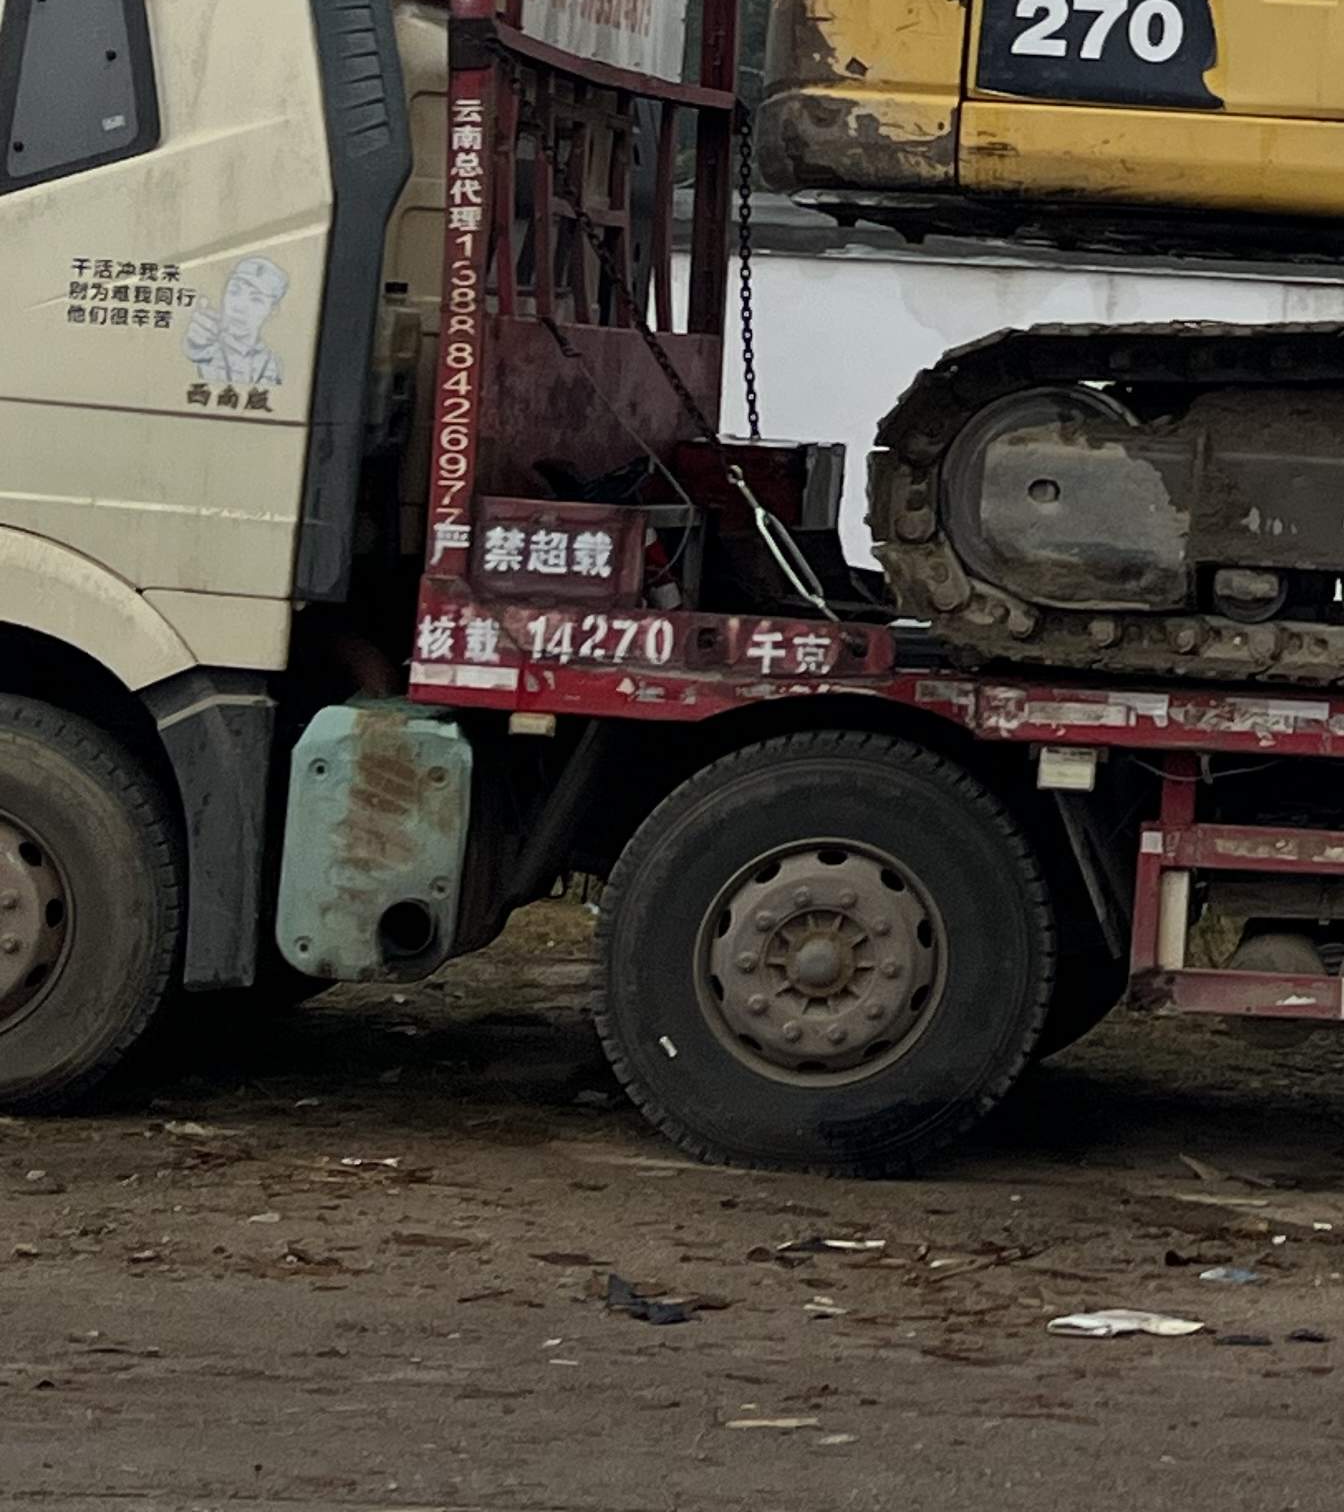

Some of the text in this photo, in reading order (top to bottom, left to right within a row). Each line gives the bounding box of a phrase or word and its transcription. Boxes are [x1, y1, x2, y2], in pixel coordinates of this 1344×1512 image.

[71, 257, 182, 283] 干活冲我来
[66, 304, 173, 329] 他们很辛苦
[417, 614, 832, 675] 核载 14270 千克
